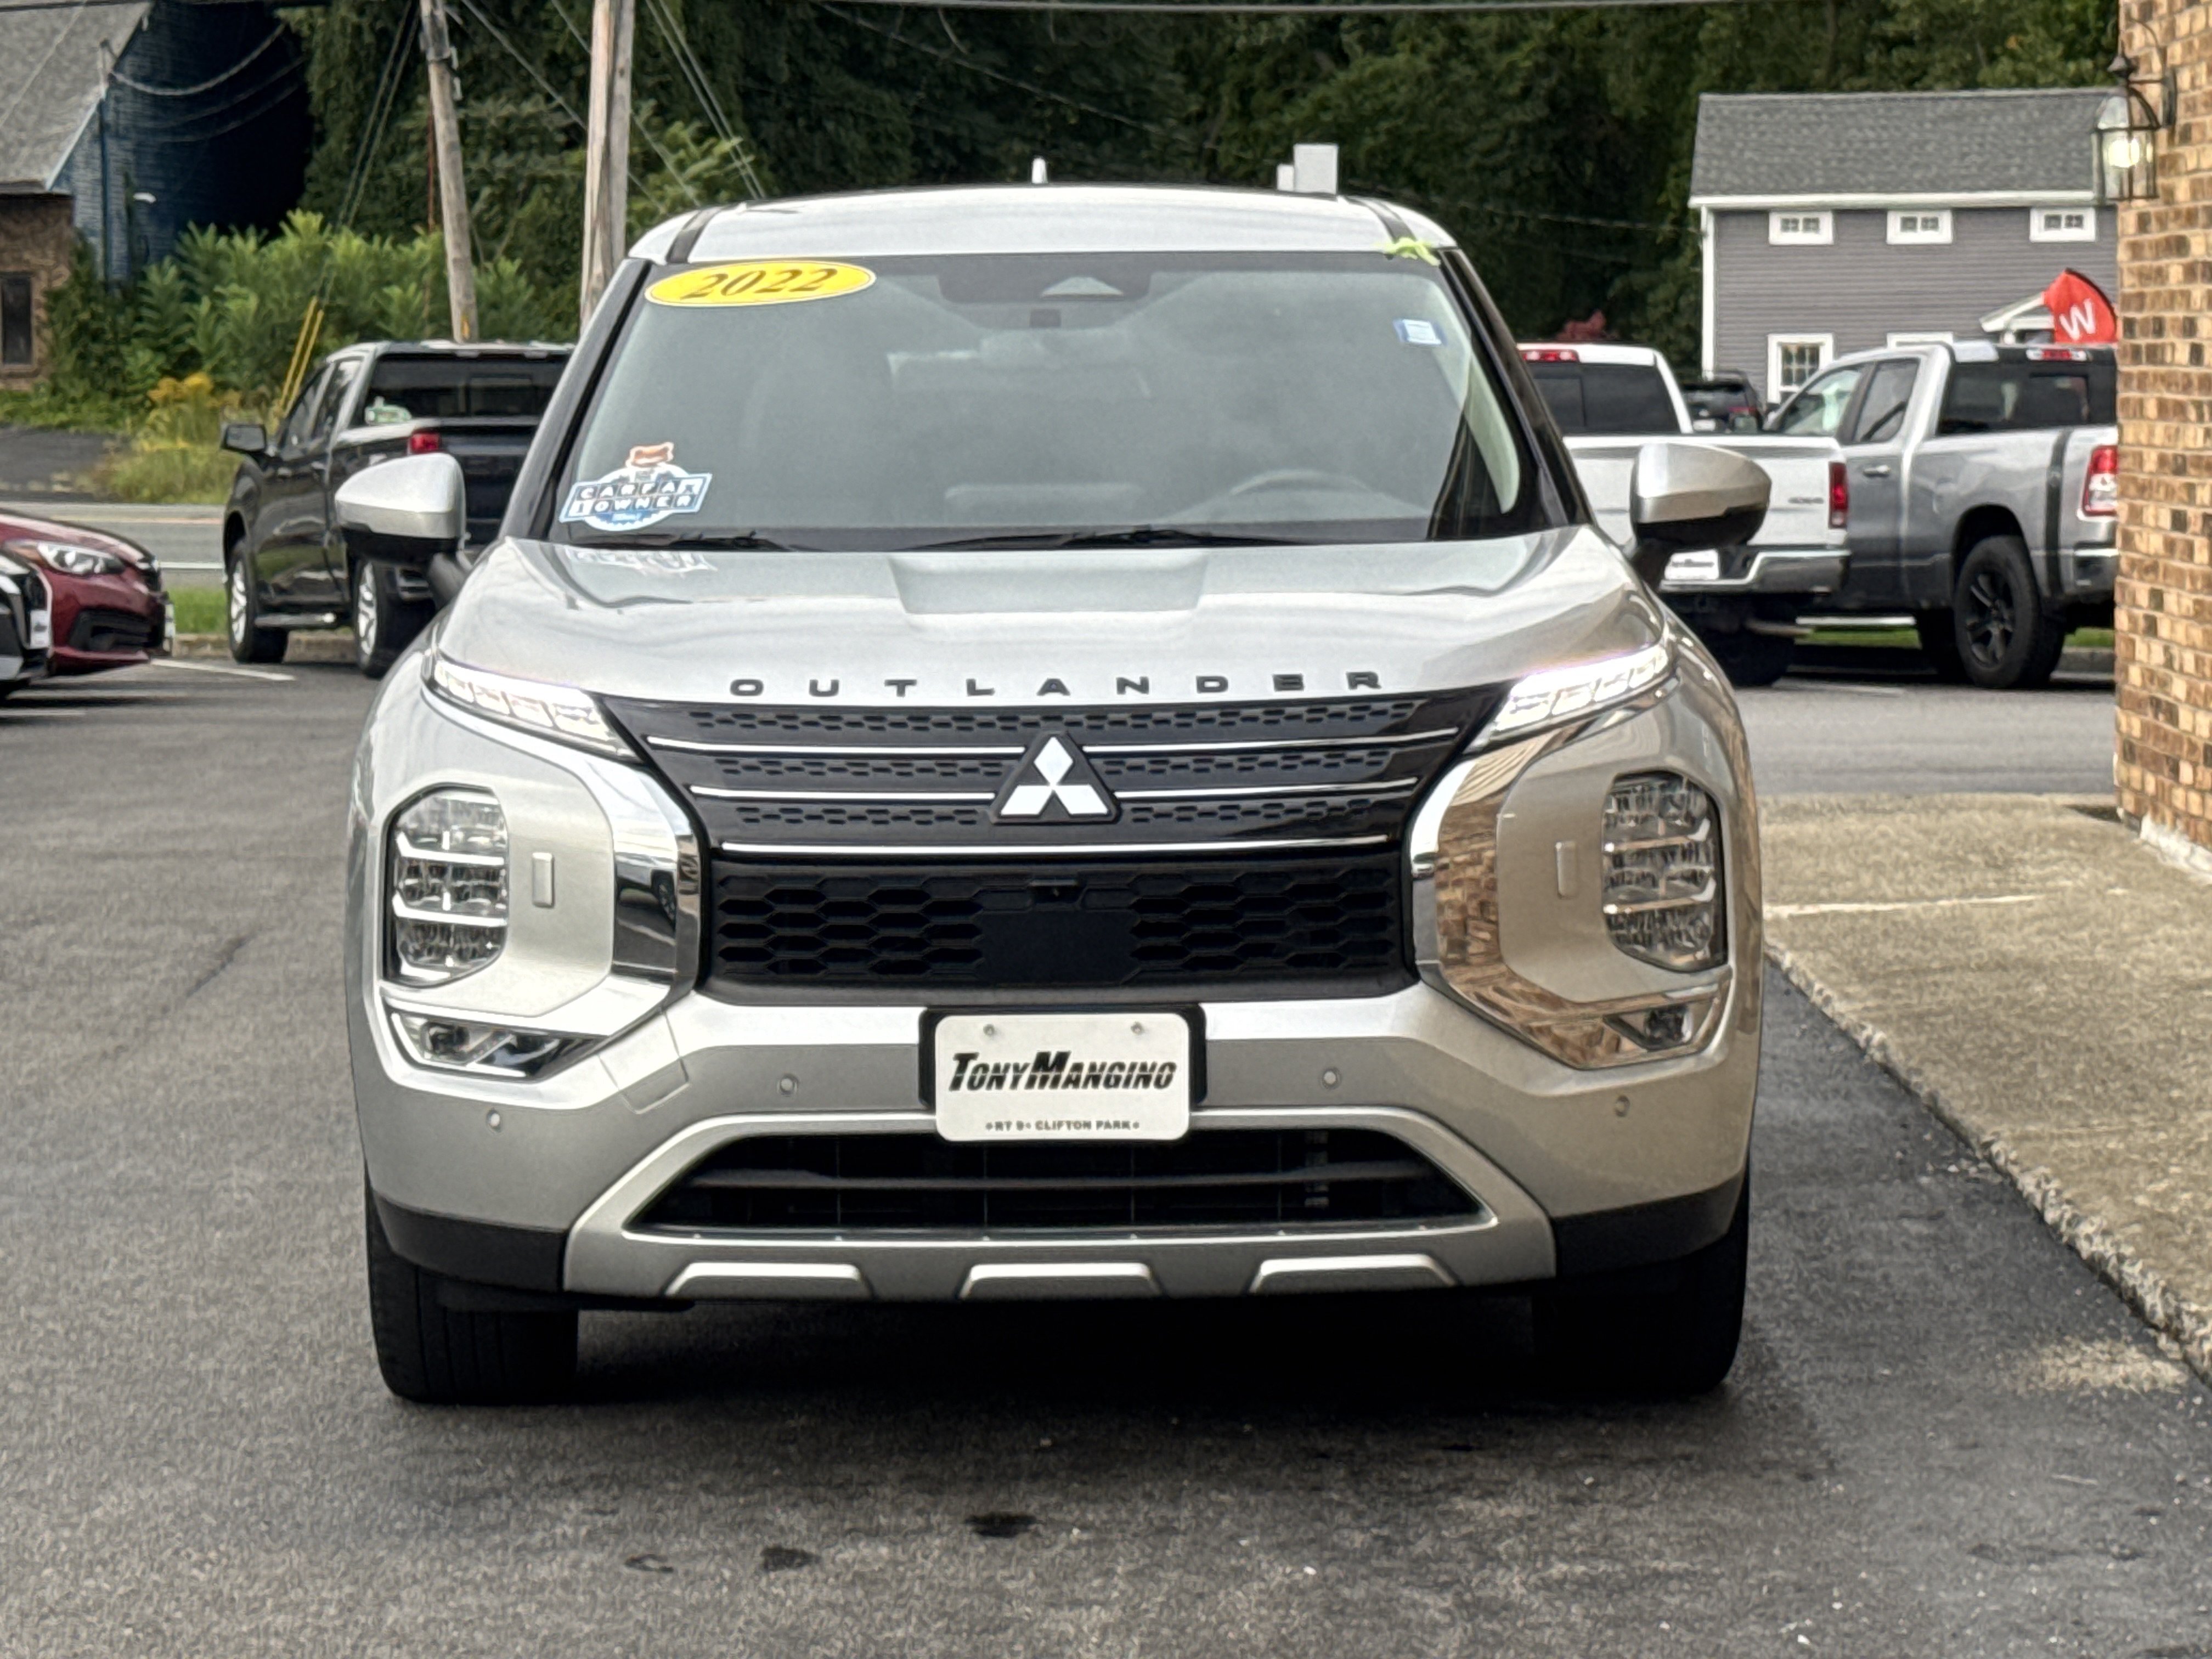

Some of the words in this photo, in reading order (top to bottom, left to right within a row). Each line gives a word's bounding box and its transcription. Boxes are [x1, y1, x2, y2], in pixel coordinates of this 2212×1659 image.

[680, 268, 838, 300] 2022
[729, 670, 1382, 698] OUTLANDER
[1035, 1120, 1092, 1131] CLIFTON
[1096, 1120, 1131, 1131] PARK
